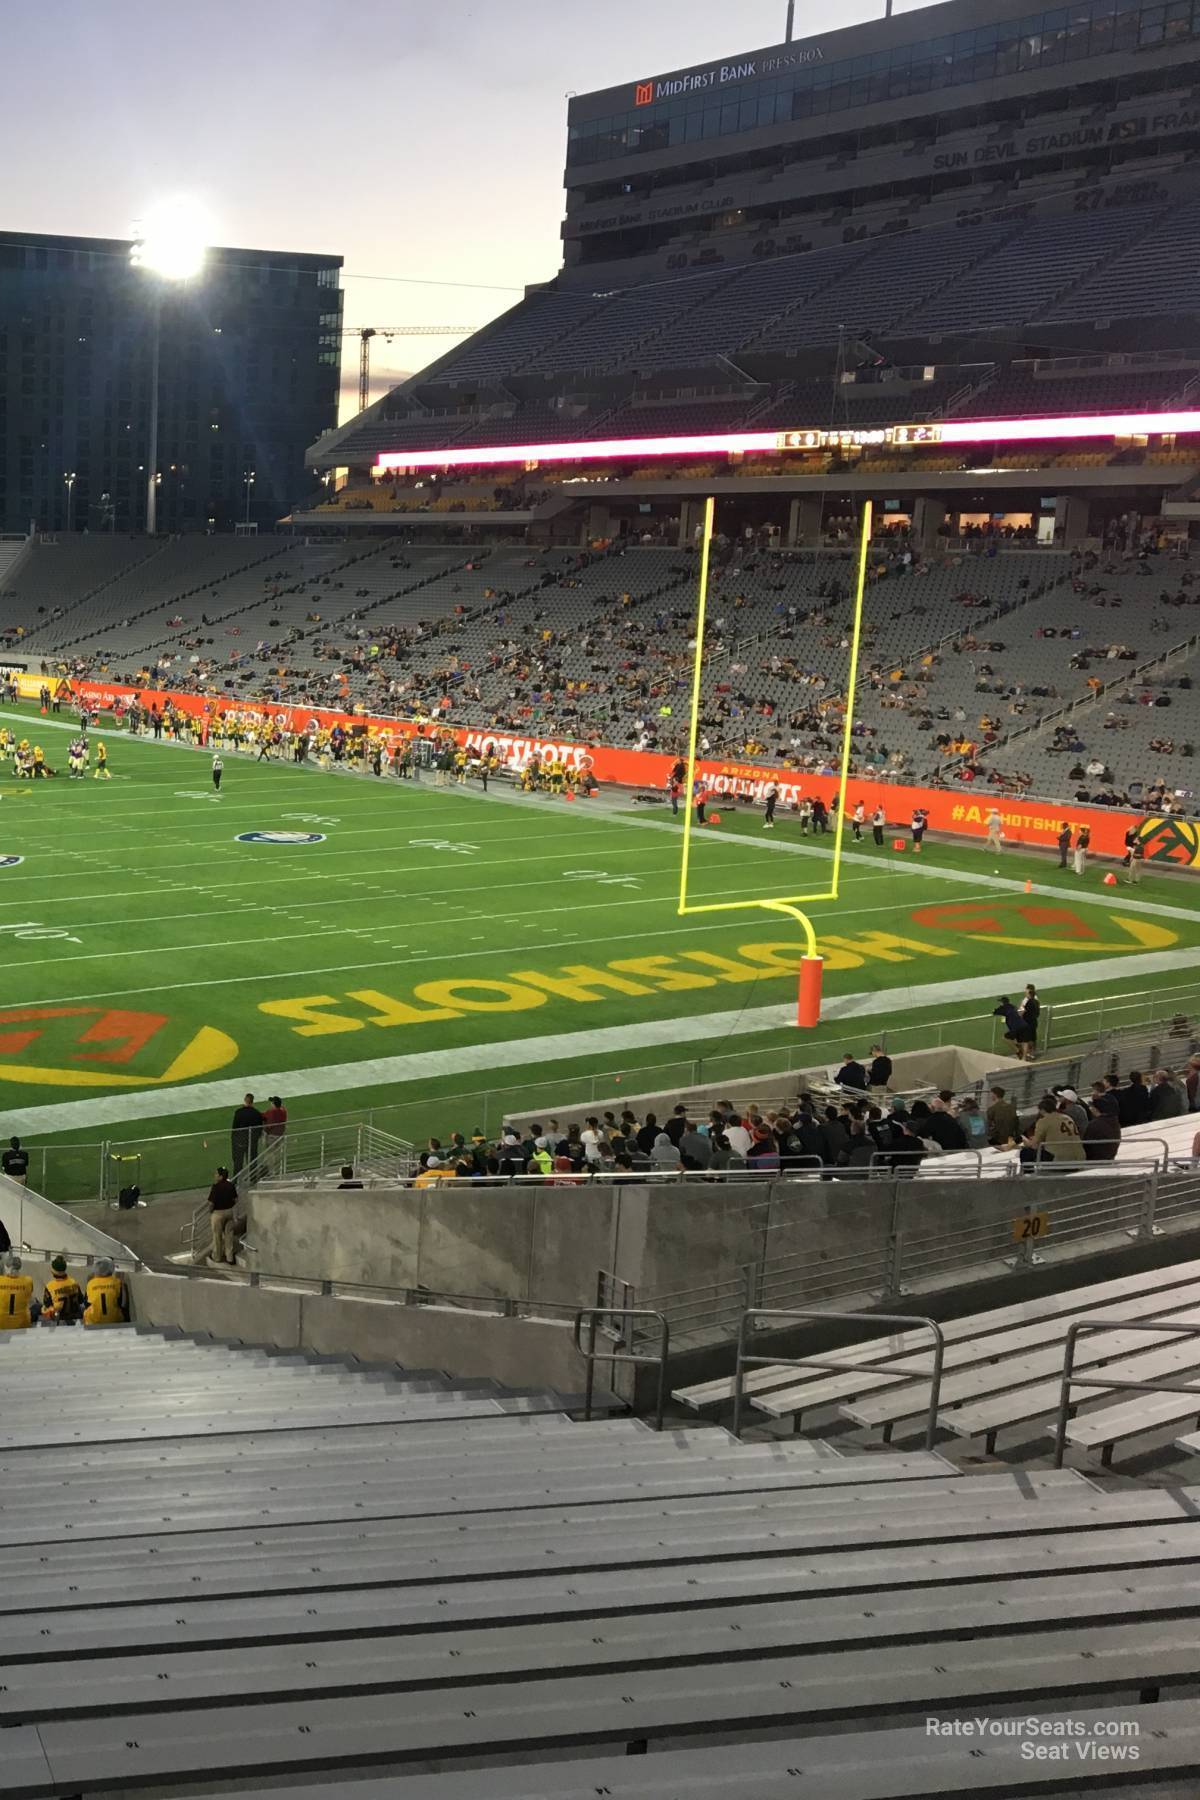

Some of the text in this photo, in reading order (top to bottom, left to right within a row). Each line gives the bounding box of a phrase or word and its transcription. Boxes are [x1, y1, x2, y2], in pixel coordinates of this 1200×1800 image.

[762, 55, 796, 73] PRESS
[799, 47, 824, 63] BOX
[932, 151, 969, 170] SUN
[973, 141, 1020, 162] DEVIL
[1026, 126, 1104, 154] STADIUM
[721, 766, 780, 781] ARIZONA
[258, 930, 960, 1038] HOTSHOTS
[1022, 1217, 1040, 1238] 20
[8, 1294, 15, 1315] 1
[100, 1293, 107, 1315] 1
